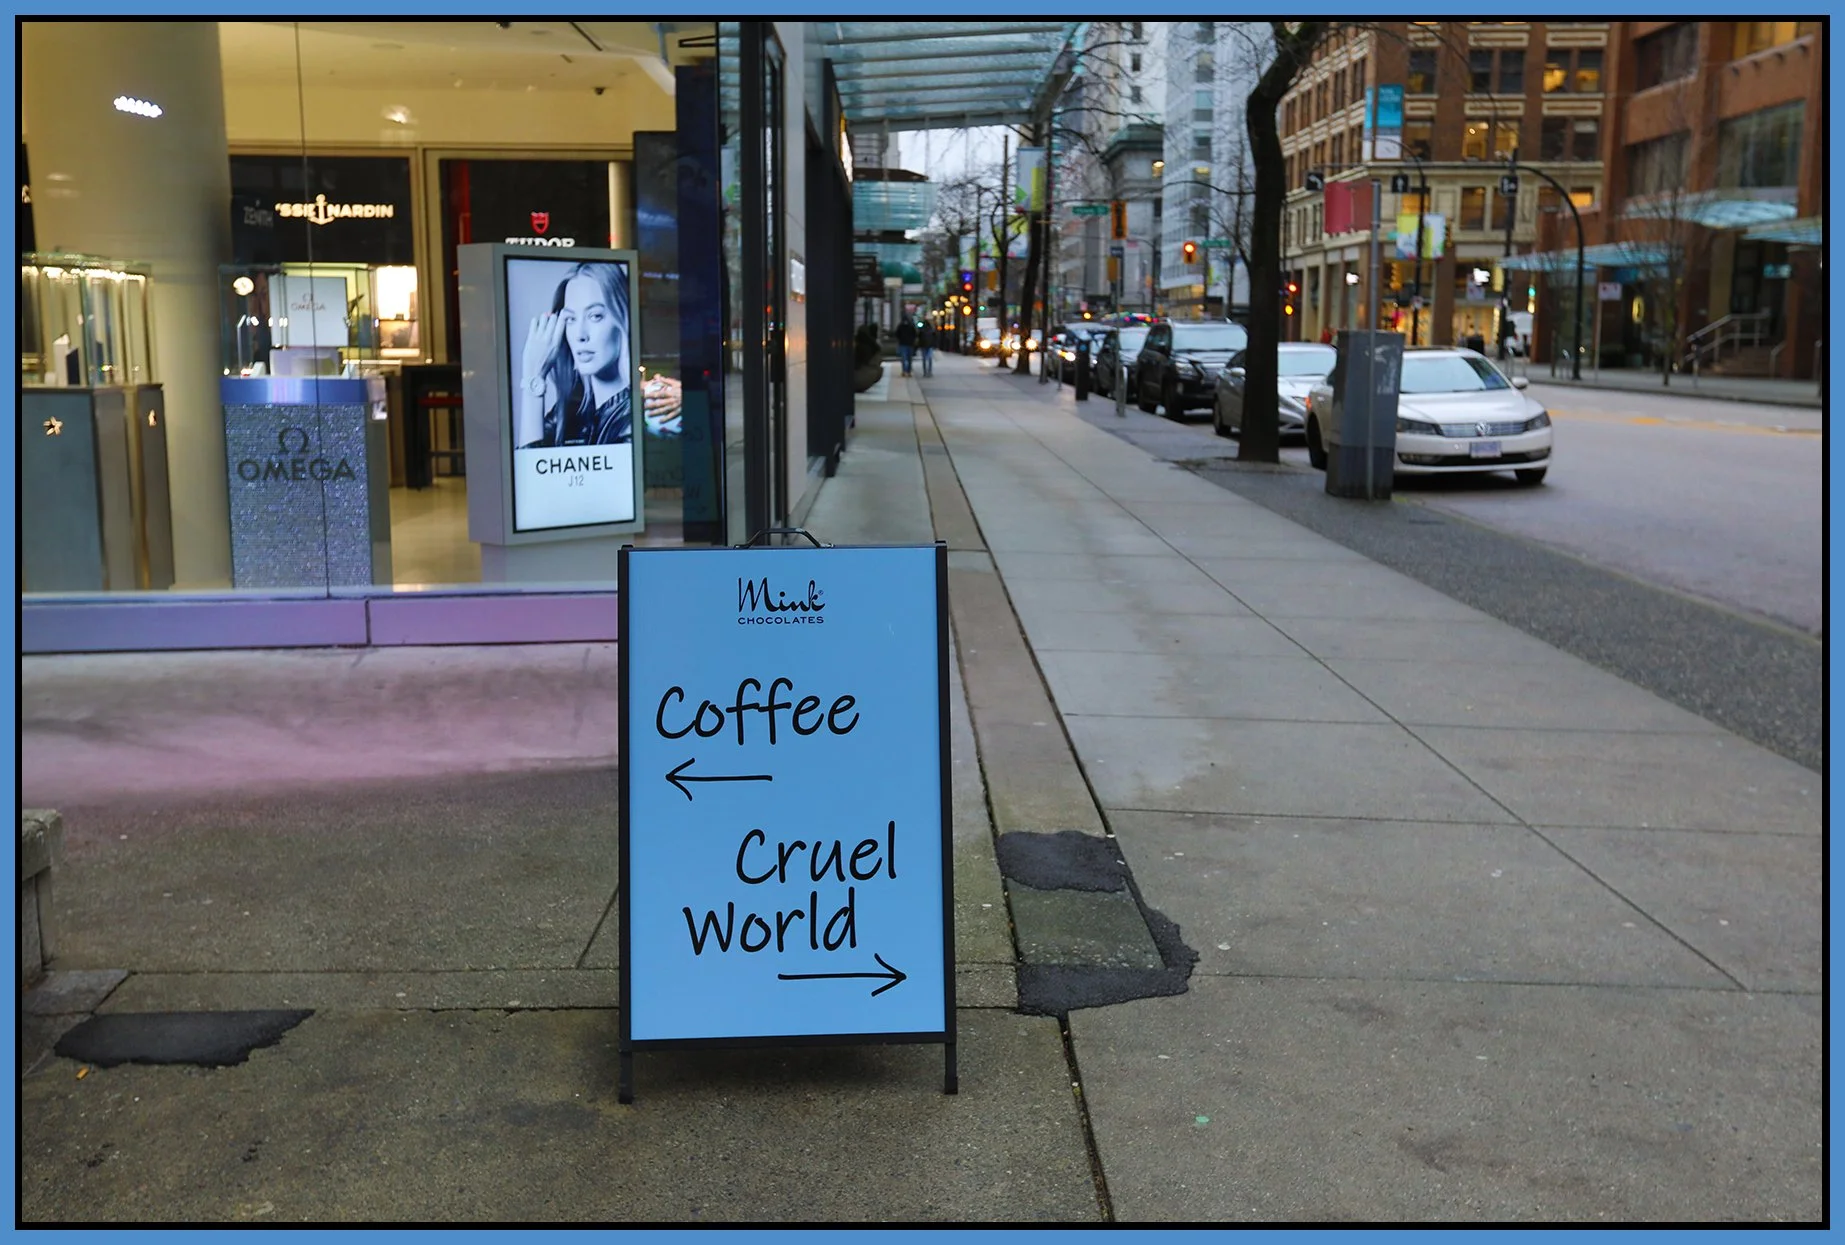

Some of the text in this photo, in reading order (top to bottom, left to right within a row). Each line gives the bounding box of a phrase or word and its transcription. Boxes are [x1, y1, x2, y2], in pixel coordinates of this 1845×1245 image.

[327, 203, 394, 218] NARDIN
[237, 458, 356, 481] OMEGA
[535, 455, 614, 475] CHANEL
[567, 474, 585, 488] J12
[738, 577, 826, 613] Mink
[737, 616, 825, 625] CHOCOLATES
[656, 677, 860, 745] Coffee
[736, 820, 897, 885] Cruel
[682, 886, 857, 956] World
